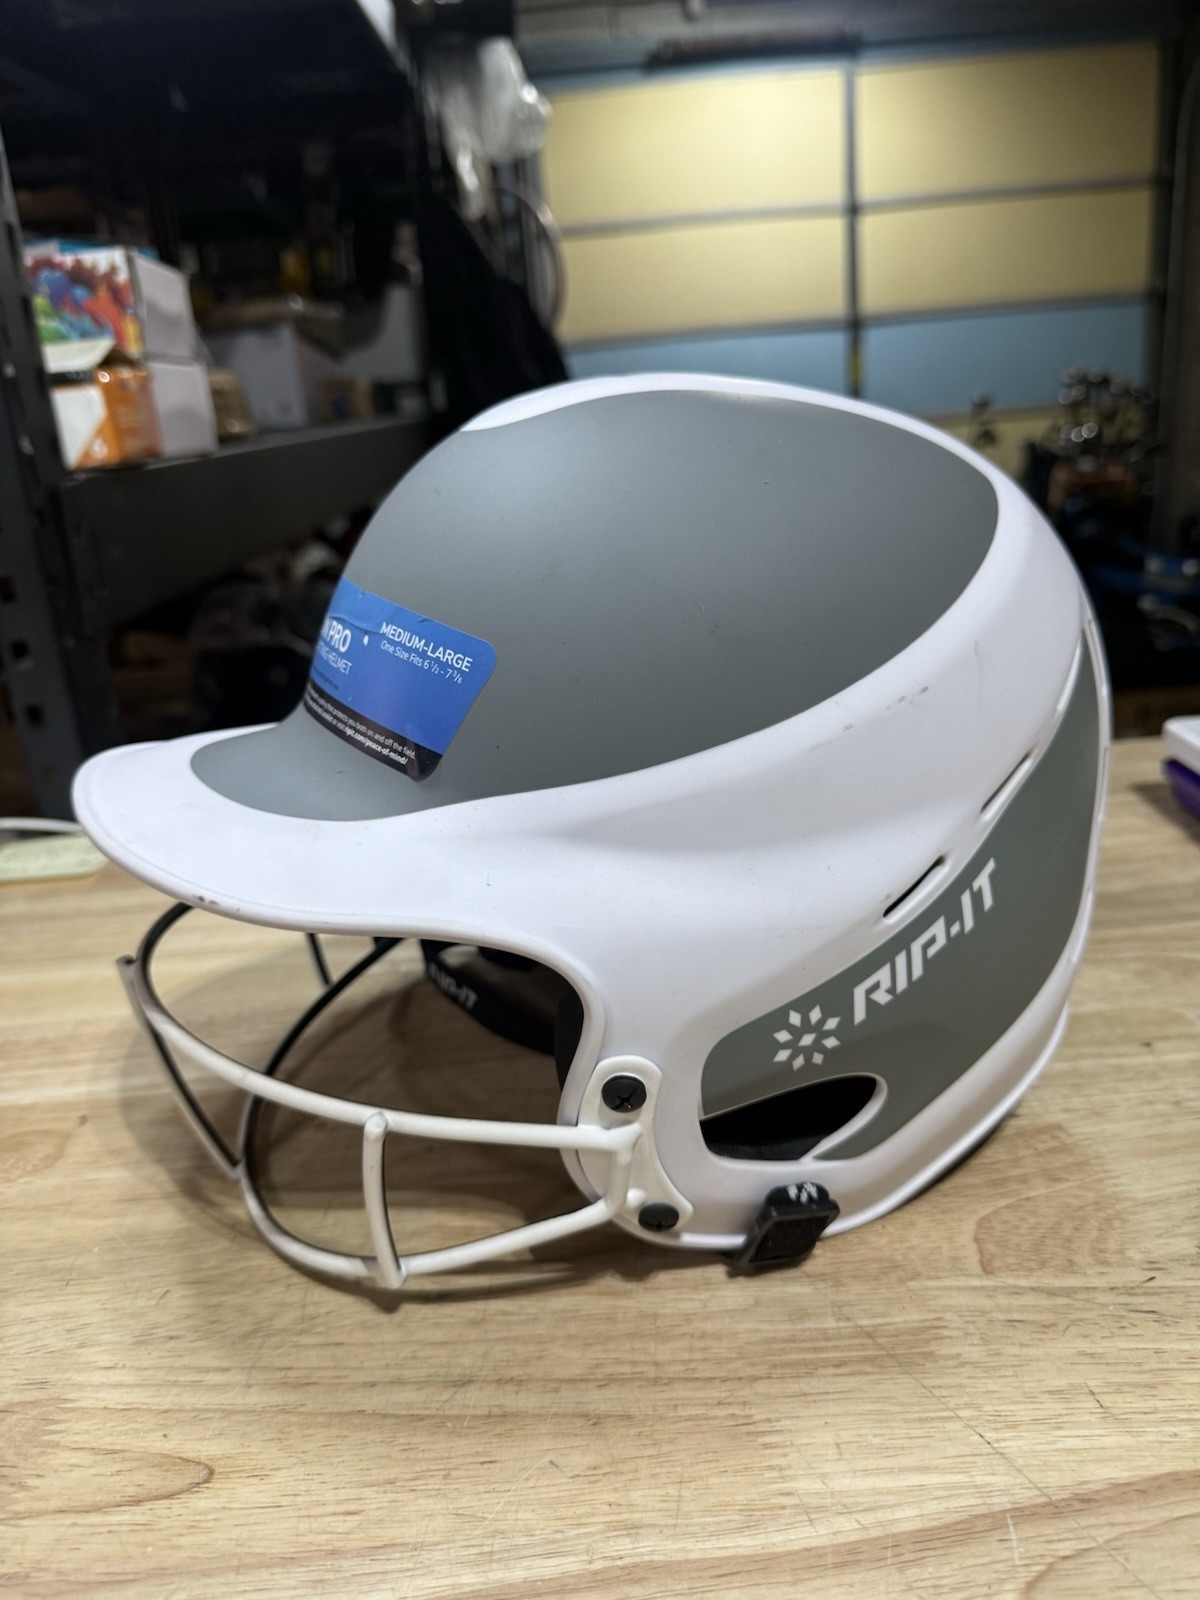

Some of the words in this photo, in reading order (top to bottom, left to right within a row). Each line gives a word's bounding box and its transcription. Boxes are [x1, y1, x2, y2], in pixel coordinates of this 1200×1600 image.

[327, 619, 352, 653] PRO
[380, 622, 473, 672] MEDIUM-LARGE
[381, 640, 395, 654] One
[394, 646, 410, 661] Size
[409, 653, 424, 667] Fits
[853, 857, 996, 1026] RIP-IT
